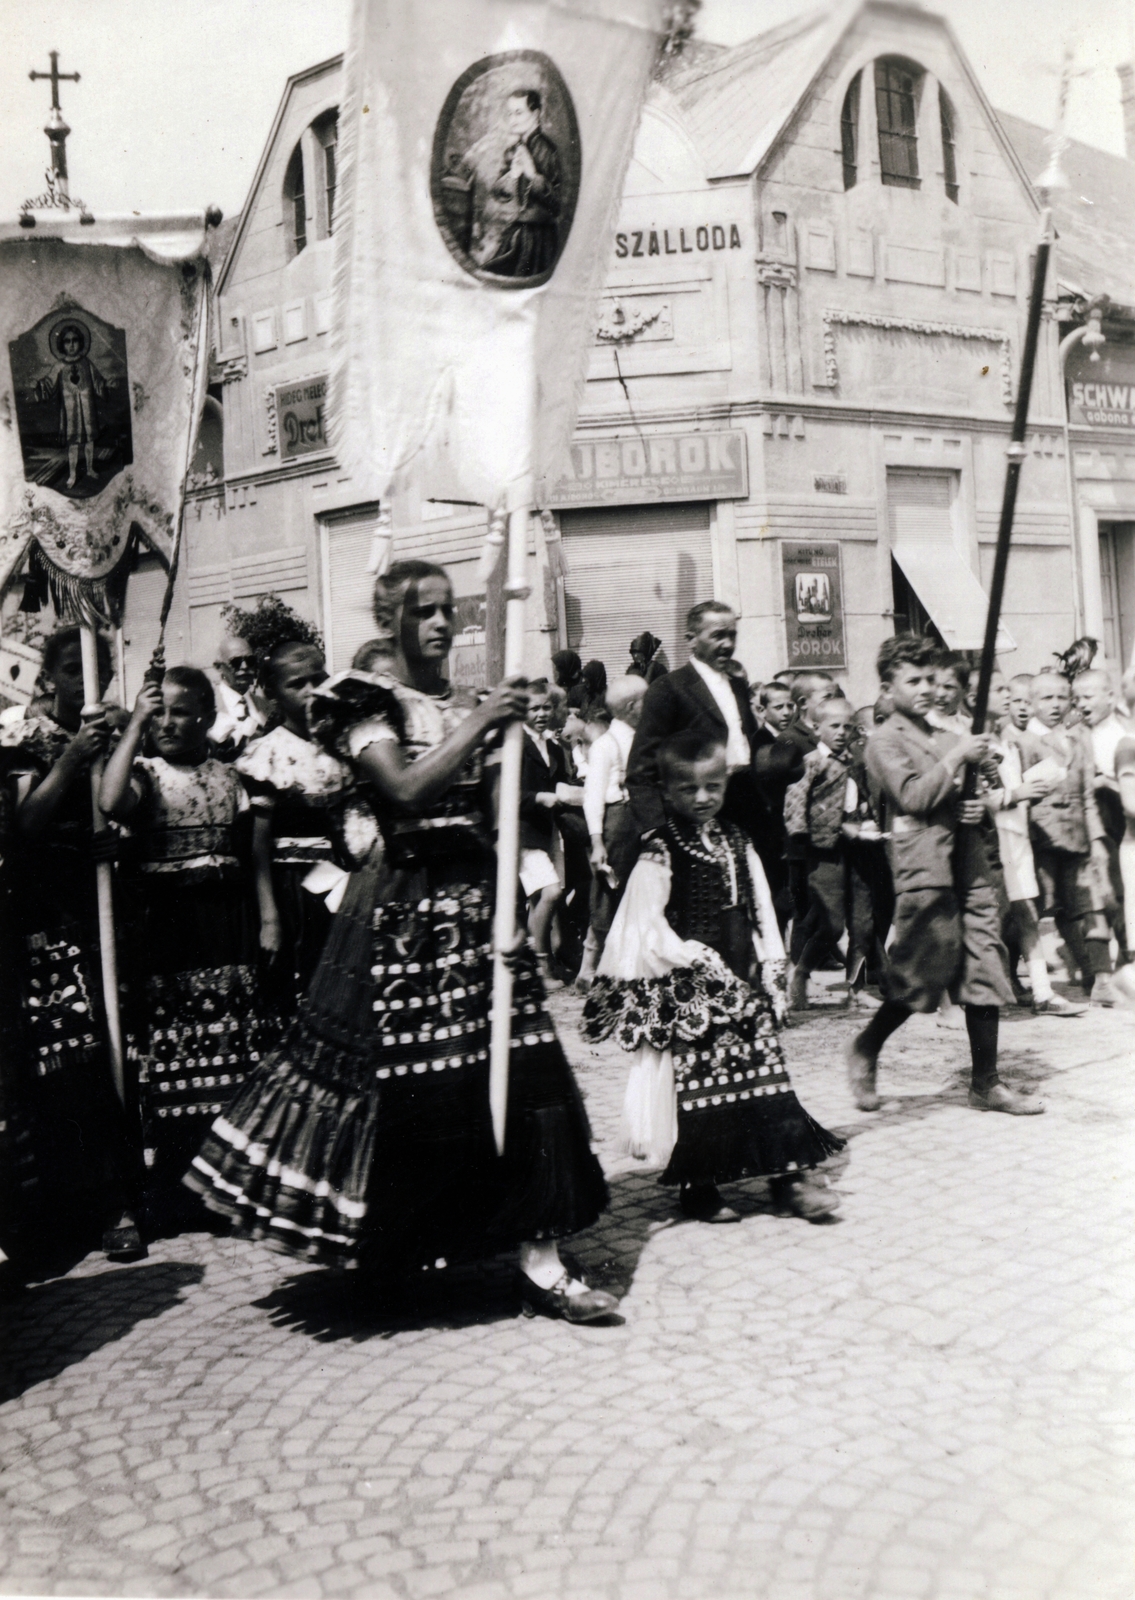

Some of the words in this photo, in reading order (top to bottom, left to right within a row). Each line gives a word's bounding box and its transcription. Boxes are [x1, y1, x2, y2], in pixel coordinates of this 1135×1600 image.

[615, 222, 741, 258] SZÁLLODA
[284, 404, 327, 452] Dreh
[554, 435, 736, 483] AJBOROK
[454, 653, 486, 677] Senato
